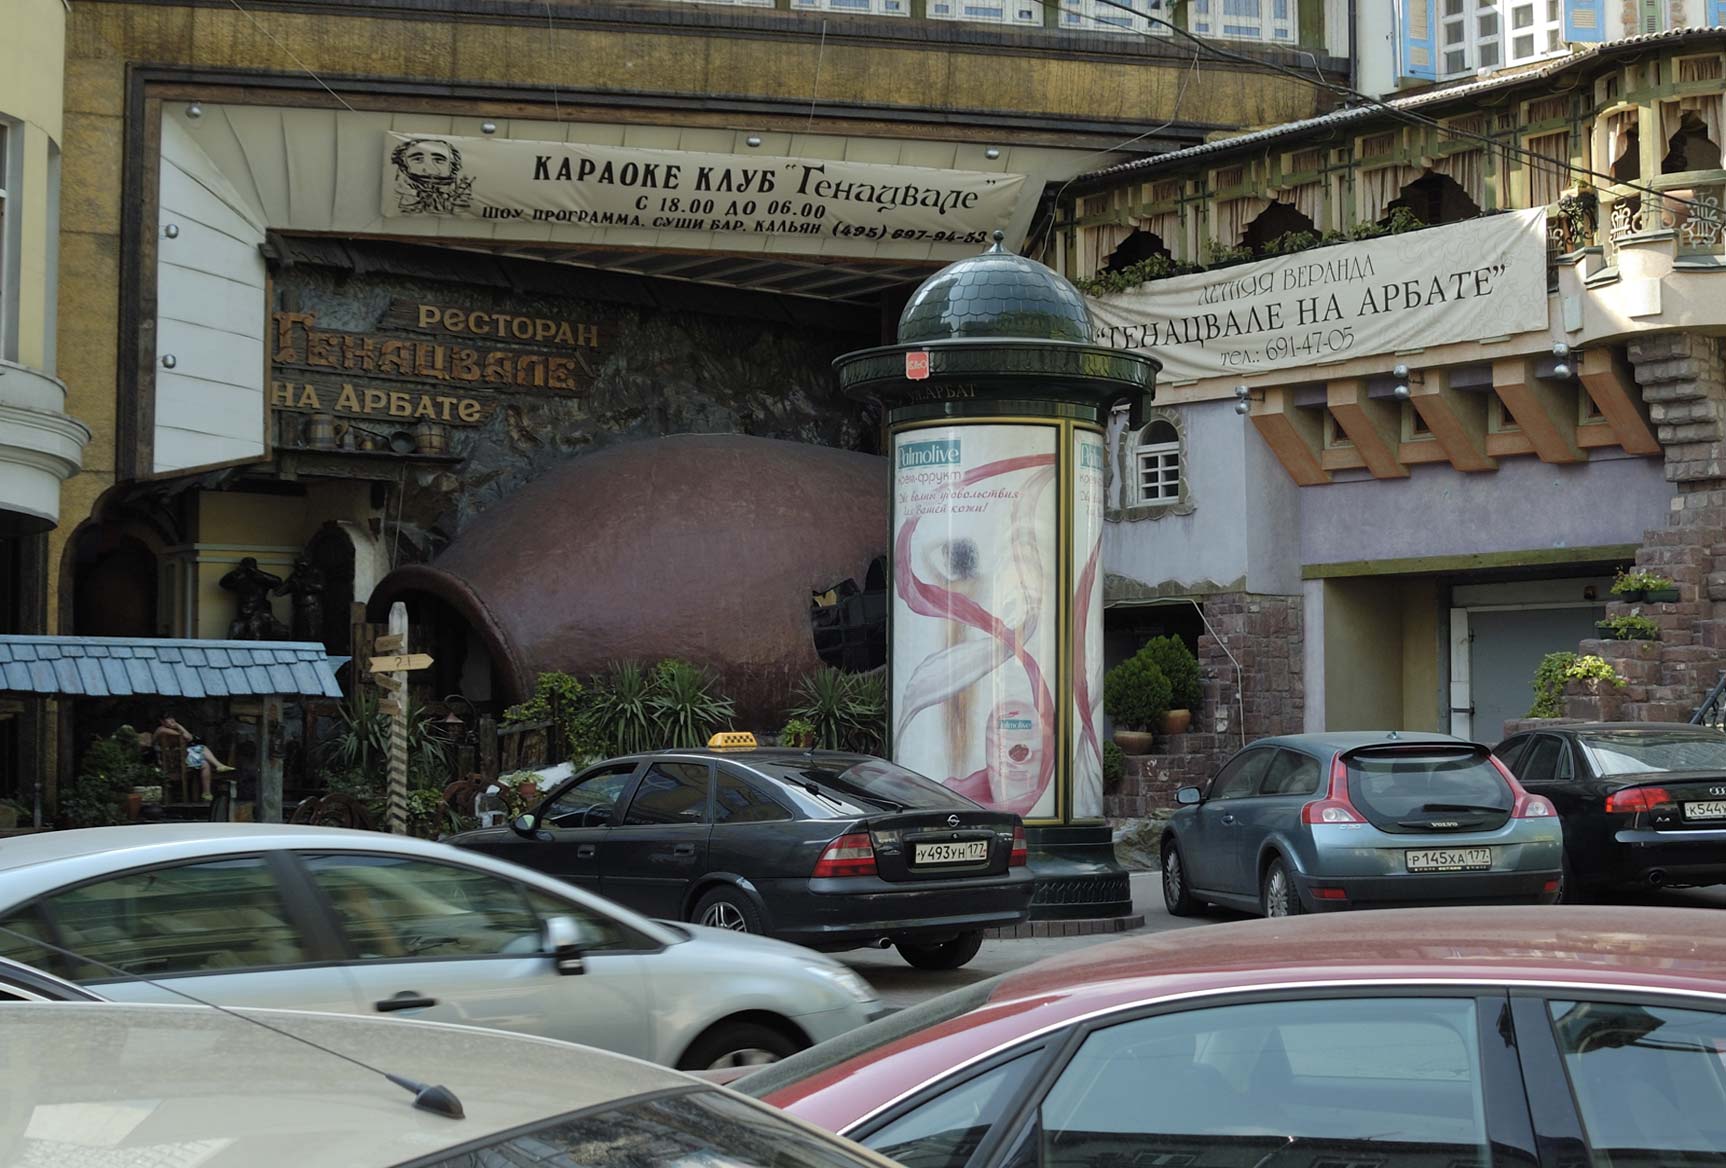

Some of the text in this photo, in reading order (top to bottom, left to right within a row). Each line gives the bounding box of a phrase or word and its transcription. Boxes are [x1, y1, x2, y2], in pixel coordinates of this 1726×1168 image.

[533, 156, 681, 190] КАРАОКЕ
[694, 167, 776, 194] КЛУБ
[482, 206, 524, 219] ШОУ
[532, 208, 646, 227] ПРОГРАММА.
[652, 217, 704, 230] СУШИ
[710, 219, 747, 232] БАР.
[754, 220, 822, 234] КАЛЬЯН
[832, 220, 887, 240] (495)
[635, 195, 826, 219] С 18.00 ДО 06.00
[1283, 253, 1375, 291] ВЕРАНДА
[1297, 292, 1342, 326] НА
[1358, 264, 1507, 317] АРБАТЕ”
[1265, 326, 1355, 361] 691-47-05
[270, 381, 320, 409] НА
[919, 843, 985, 861] У493УН 177
[1412, 849, 1487, 866] Р145ХА 177
